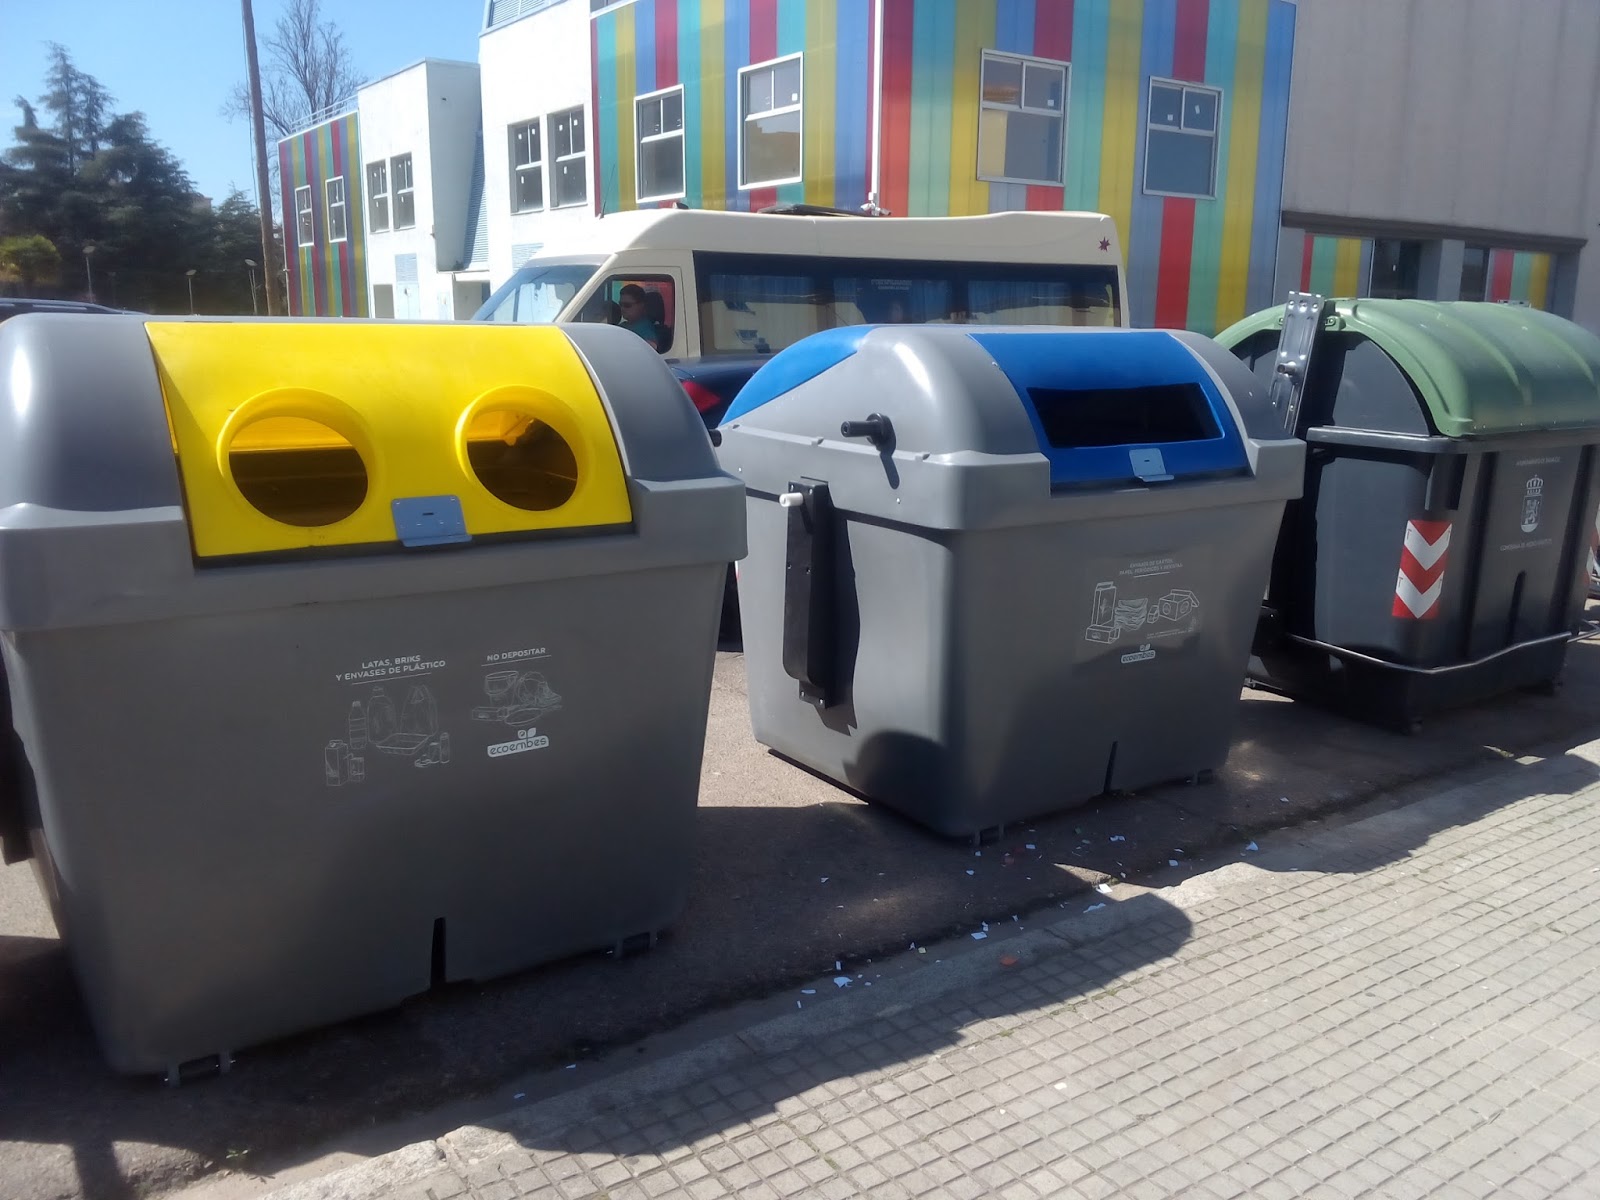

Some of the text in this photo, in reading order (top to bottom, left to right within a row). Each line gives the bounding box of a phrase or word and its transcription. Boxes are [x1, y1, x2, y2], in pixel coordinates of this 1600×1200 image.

[394, 655, 421, 665] BRIKS
[486, 647, 546, 661] NO DEPOSITAR
[344, 668, 386, 680] ENVASES
[388, 666, 401, 674] DE
[403, 660, 446, 672] PLÁSTICO
[489, 736, 548, 756] ecoembes
